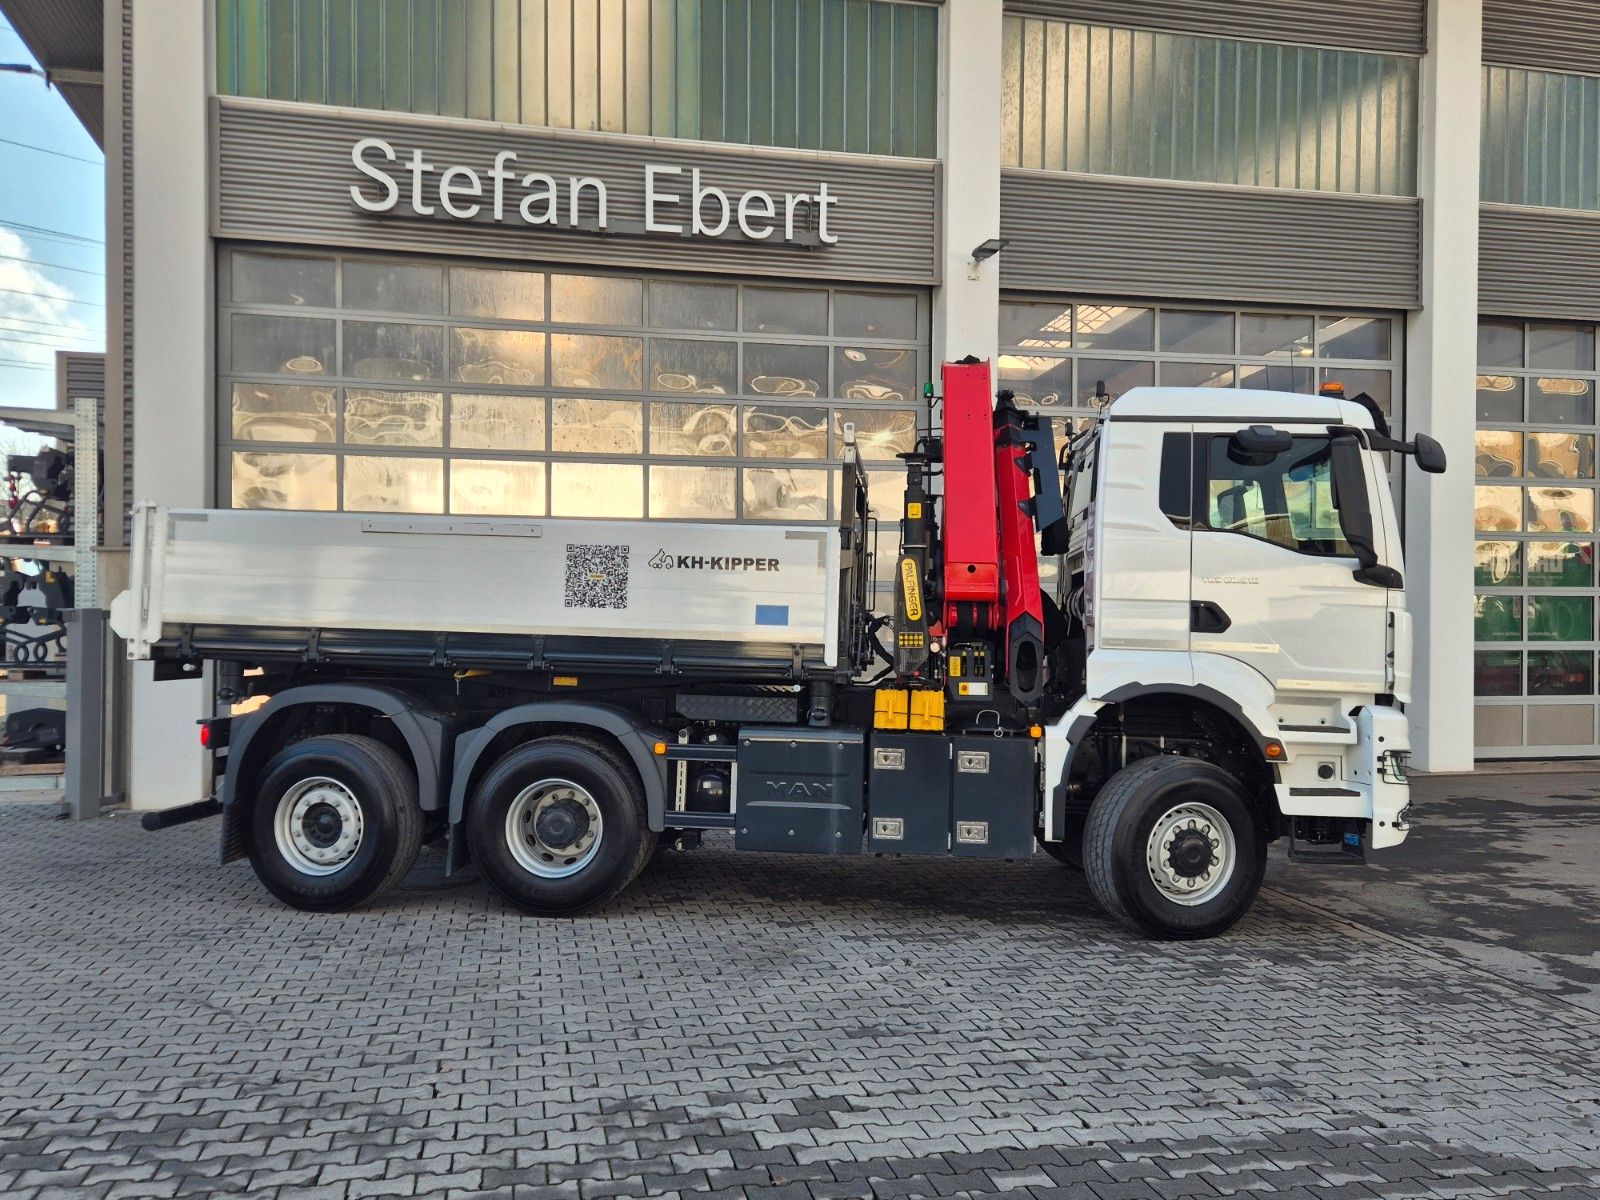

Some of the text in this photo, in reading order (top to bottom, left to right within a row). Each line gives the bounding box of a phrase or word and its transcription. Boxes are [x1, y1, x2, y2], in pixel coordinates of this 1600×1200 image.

[350, 138, 838, 244] Stefan Ebert
[677, 555, 780, 572] KH-KIPPER
[904, 562, 918, 617] PALFINGER
